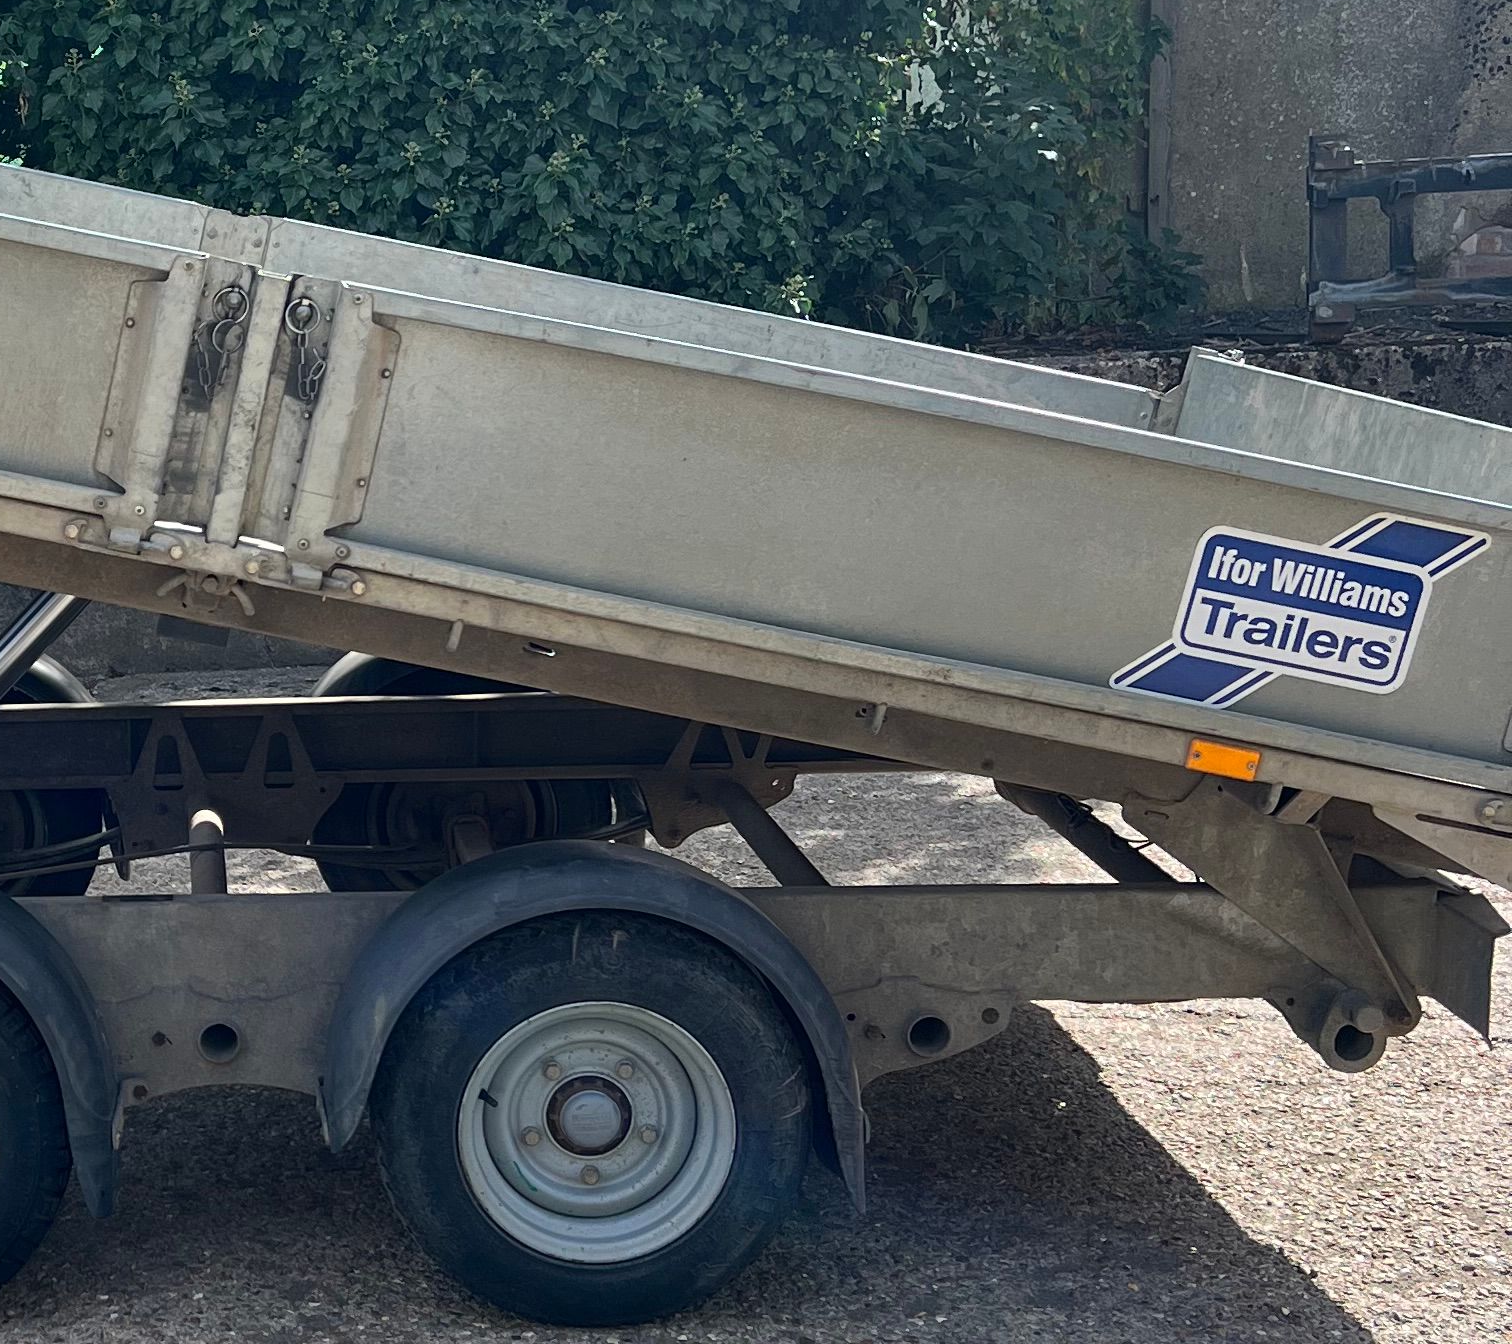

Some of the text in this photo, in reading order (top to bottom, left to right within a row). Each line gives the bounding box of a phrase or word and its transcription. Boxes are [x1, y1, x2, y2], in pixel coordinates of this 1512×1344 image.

[1207, 546, 1410, 618] Ifor Williams
[1200, 597, 1392, 670] Trailers
